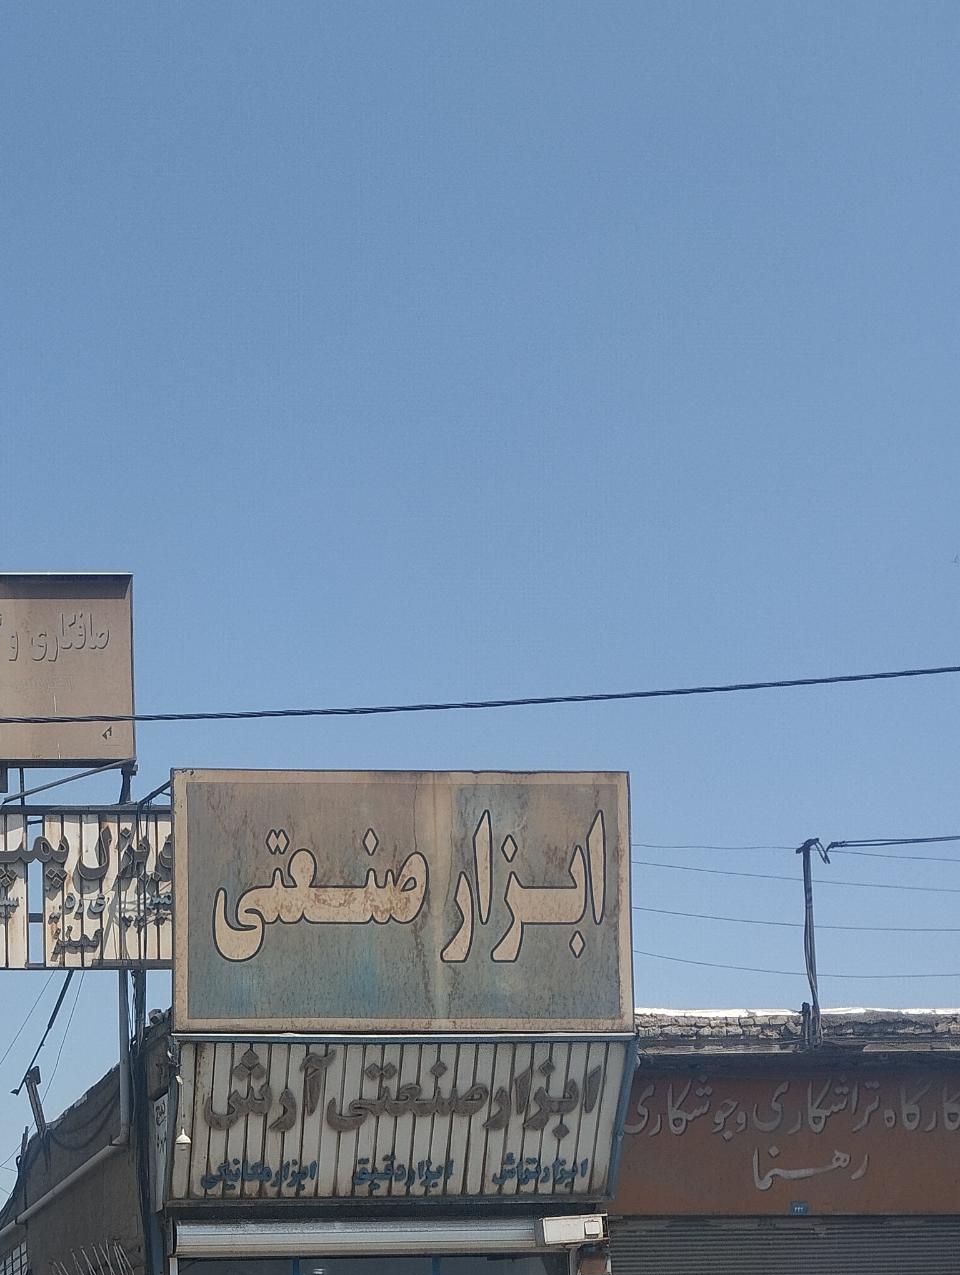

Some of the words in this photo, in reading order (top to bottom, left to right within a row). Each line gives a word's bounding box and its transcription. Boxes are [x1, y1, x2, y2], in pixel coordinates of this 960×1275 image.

[8, 631, 20, 662] و
[31, 610, 110, 663] صافکاری
[212, 827, 430, 963] صنعتی
[440, 809, 607, 963] ابزار
[203, 1048, 337, 1132] آرش
[326, 1061, 490, 1132] صنعتی
[483, 1059, 604, 1140] ابزار
[753, 1075, 881, 1135] تراشکاری
[271, 1158, 318, 1191] ابزار
[352, 1153, 406, 1190] دقیق
[405, 1157, 454, 1189] ابزار
[540, 1157, 589, 1189] ابزار
[752, 1146, 870, 1191] رهنما
